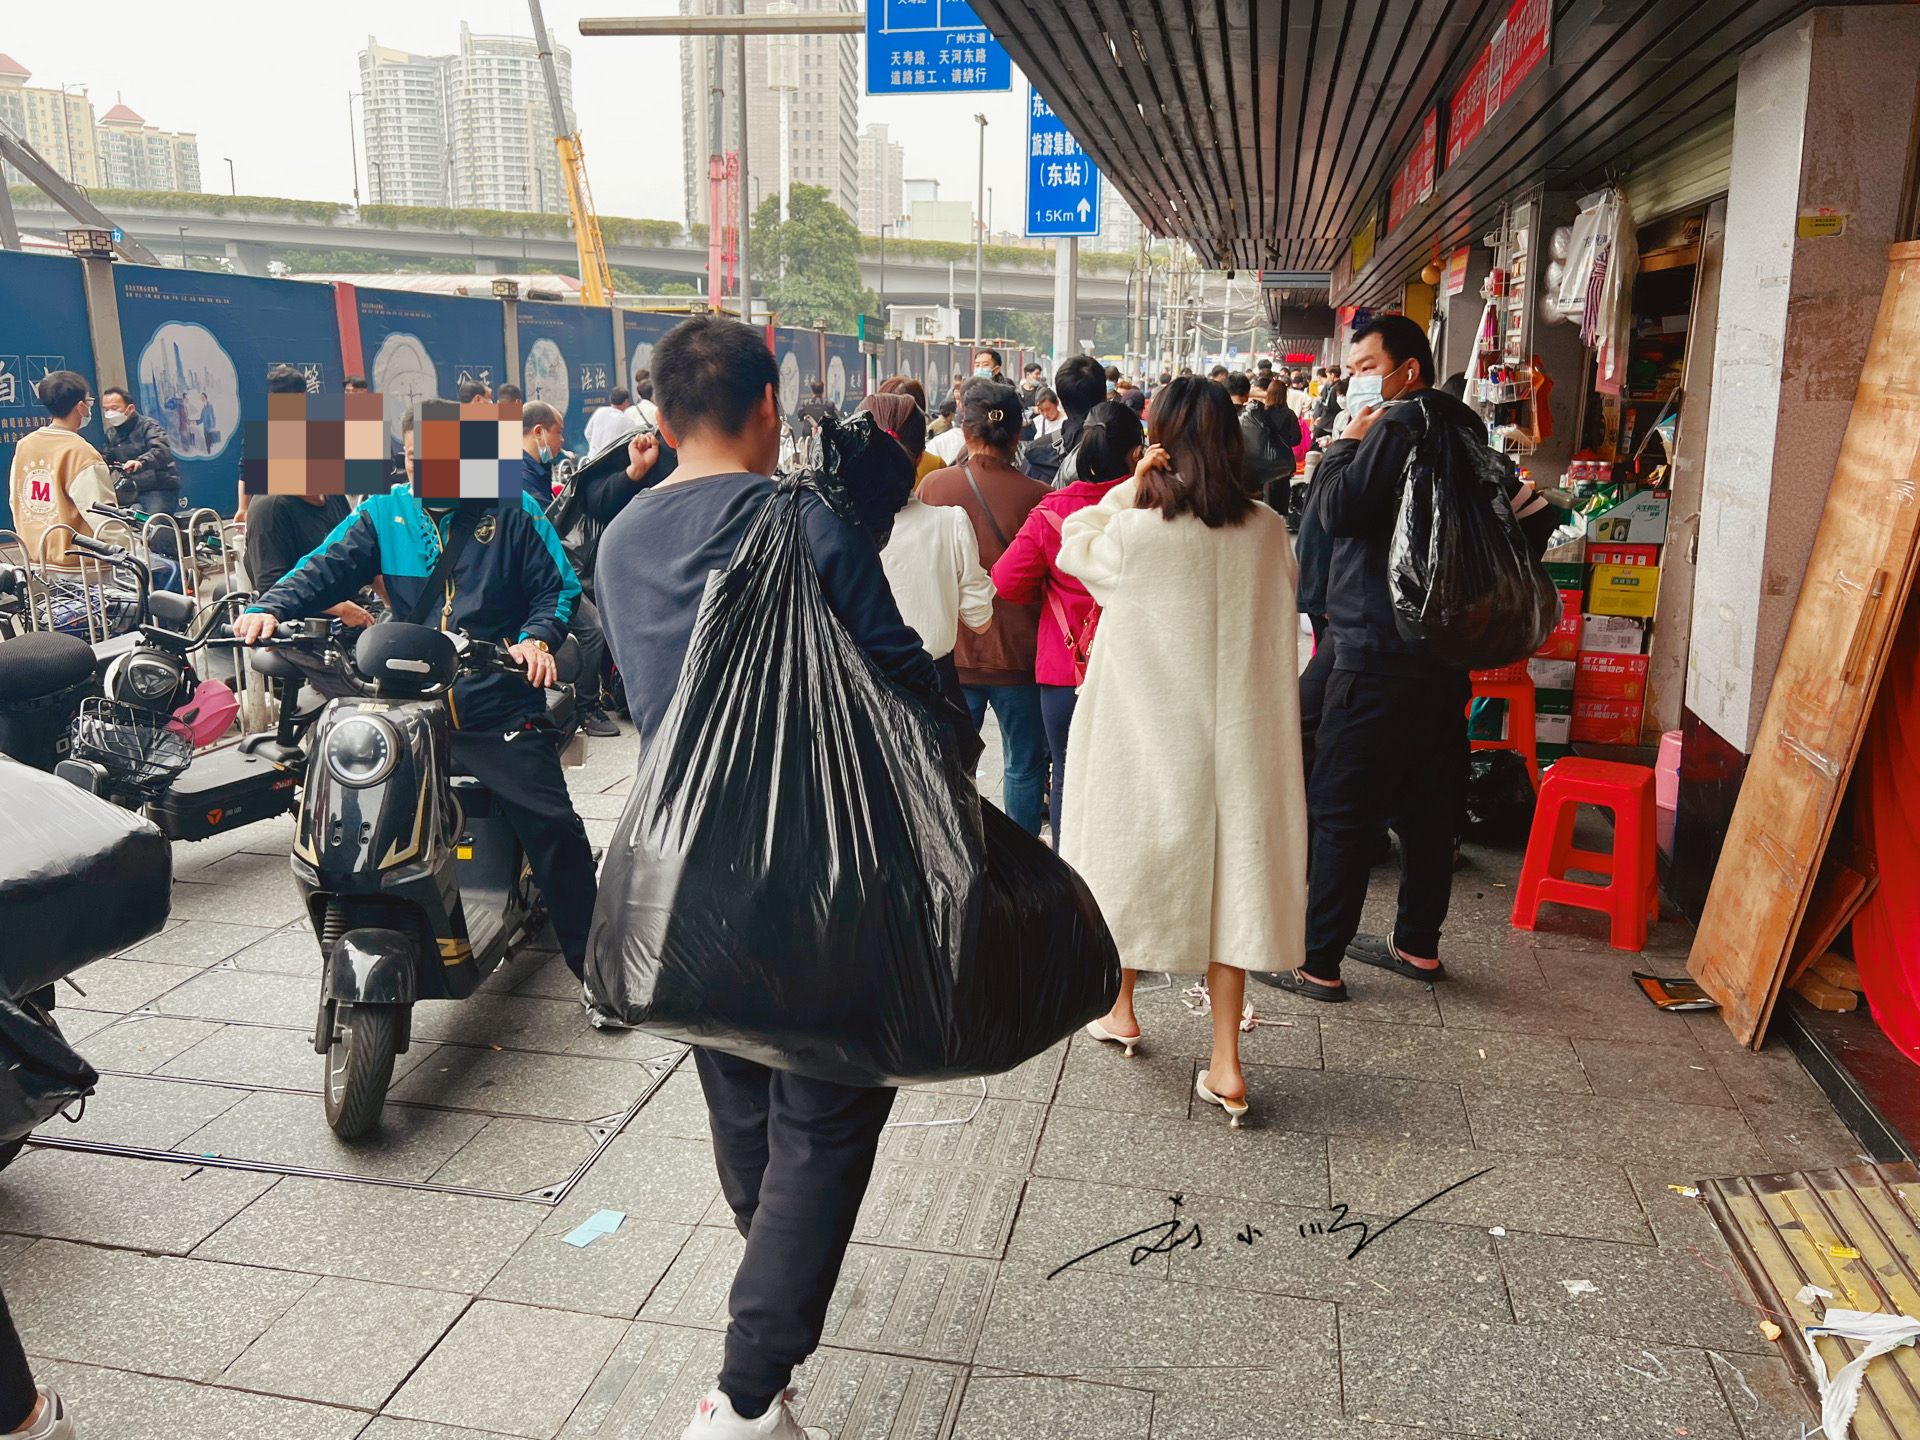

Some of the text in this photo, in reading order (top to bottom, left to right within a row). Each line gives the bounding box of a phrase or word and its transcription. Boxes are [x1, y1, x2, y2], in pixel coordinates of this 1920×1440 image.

[946, 33, 986, 44] 广州大道
[1041, 161, 1088, 187] （东站）
[1035, 209, 1074, 222] 1.5Km
[31, 480, 50, 502] M
